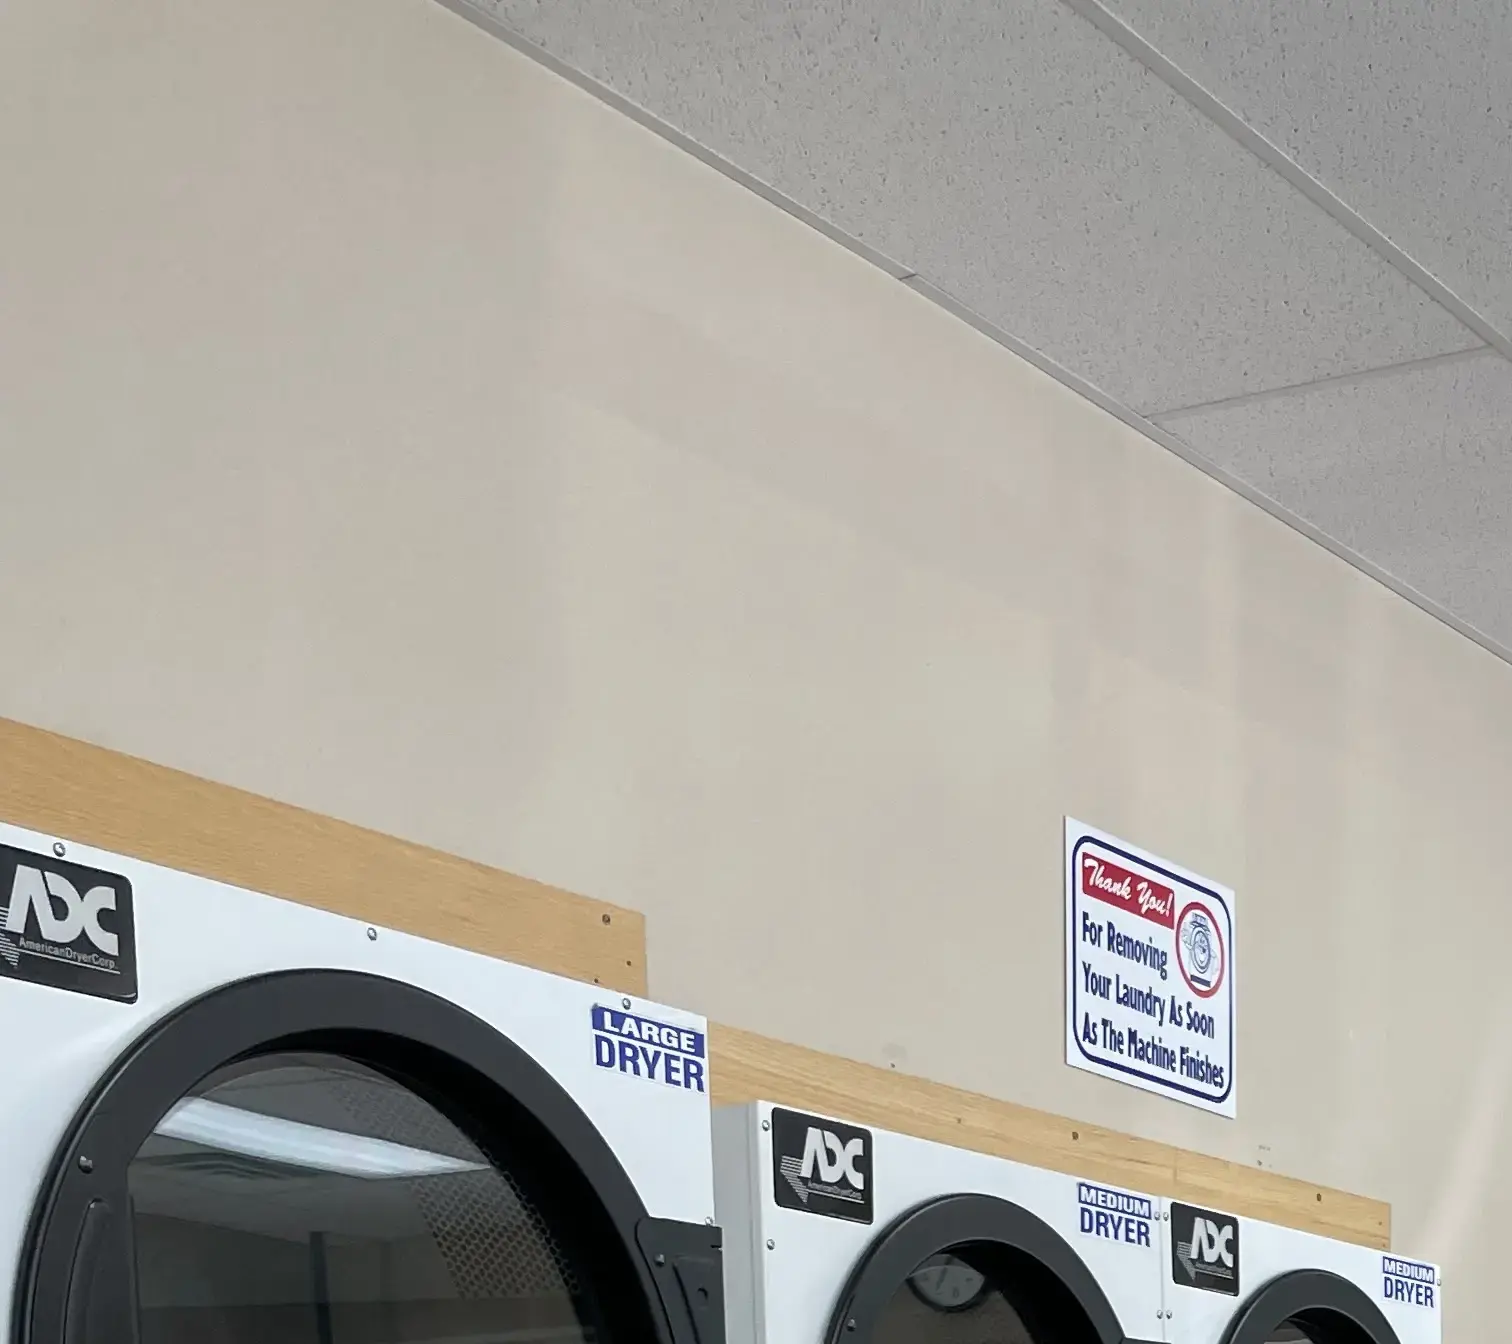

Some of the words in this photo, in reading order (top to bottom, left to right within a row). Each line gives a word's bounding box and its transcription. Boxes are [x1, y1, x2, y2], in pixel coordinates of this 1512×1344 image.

[5, 864, 119, 956] ADC
[1084, 858, 1132, 901] Thank
[1137, 882, 1173, 917] You!
[1082, 911, 1103, 948] For
[1107, 920, 1167, 980] Removing
[1082, 961, 1110, 1001] Your
[1115, 974, 1166, 1027] Laundry
[1169, 996, 1183, 1028] As
[1186, 1001, 1215, 1039] Soon
[604, 1011, 695, 1052] LARGE
[1082, 1012, 1097, 1045] As
[1102, 1019, 1124, 1055] The
[1128, 1027, 1176, 1072] Machine
[1180, 1046, 1224, 1089] Finishes
[595, 1034, 704, 1092] DRYER
[800, 1126, 864, 1190] ADC
[1080, 1185, 1149, 1217] MEDIUM
[1080, 1207, 1151, 1247] DRYER
[1190, 1217, 1234, 1268] ADC
[1384, 1258, 1433, 1283] MEDIUM
[1384, 1276, 1434, 1308] DRYER
